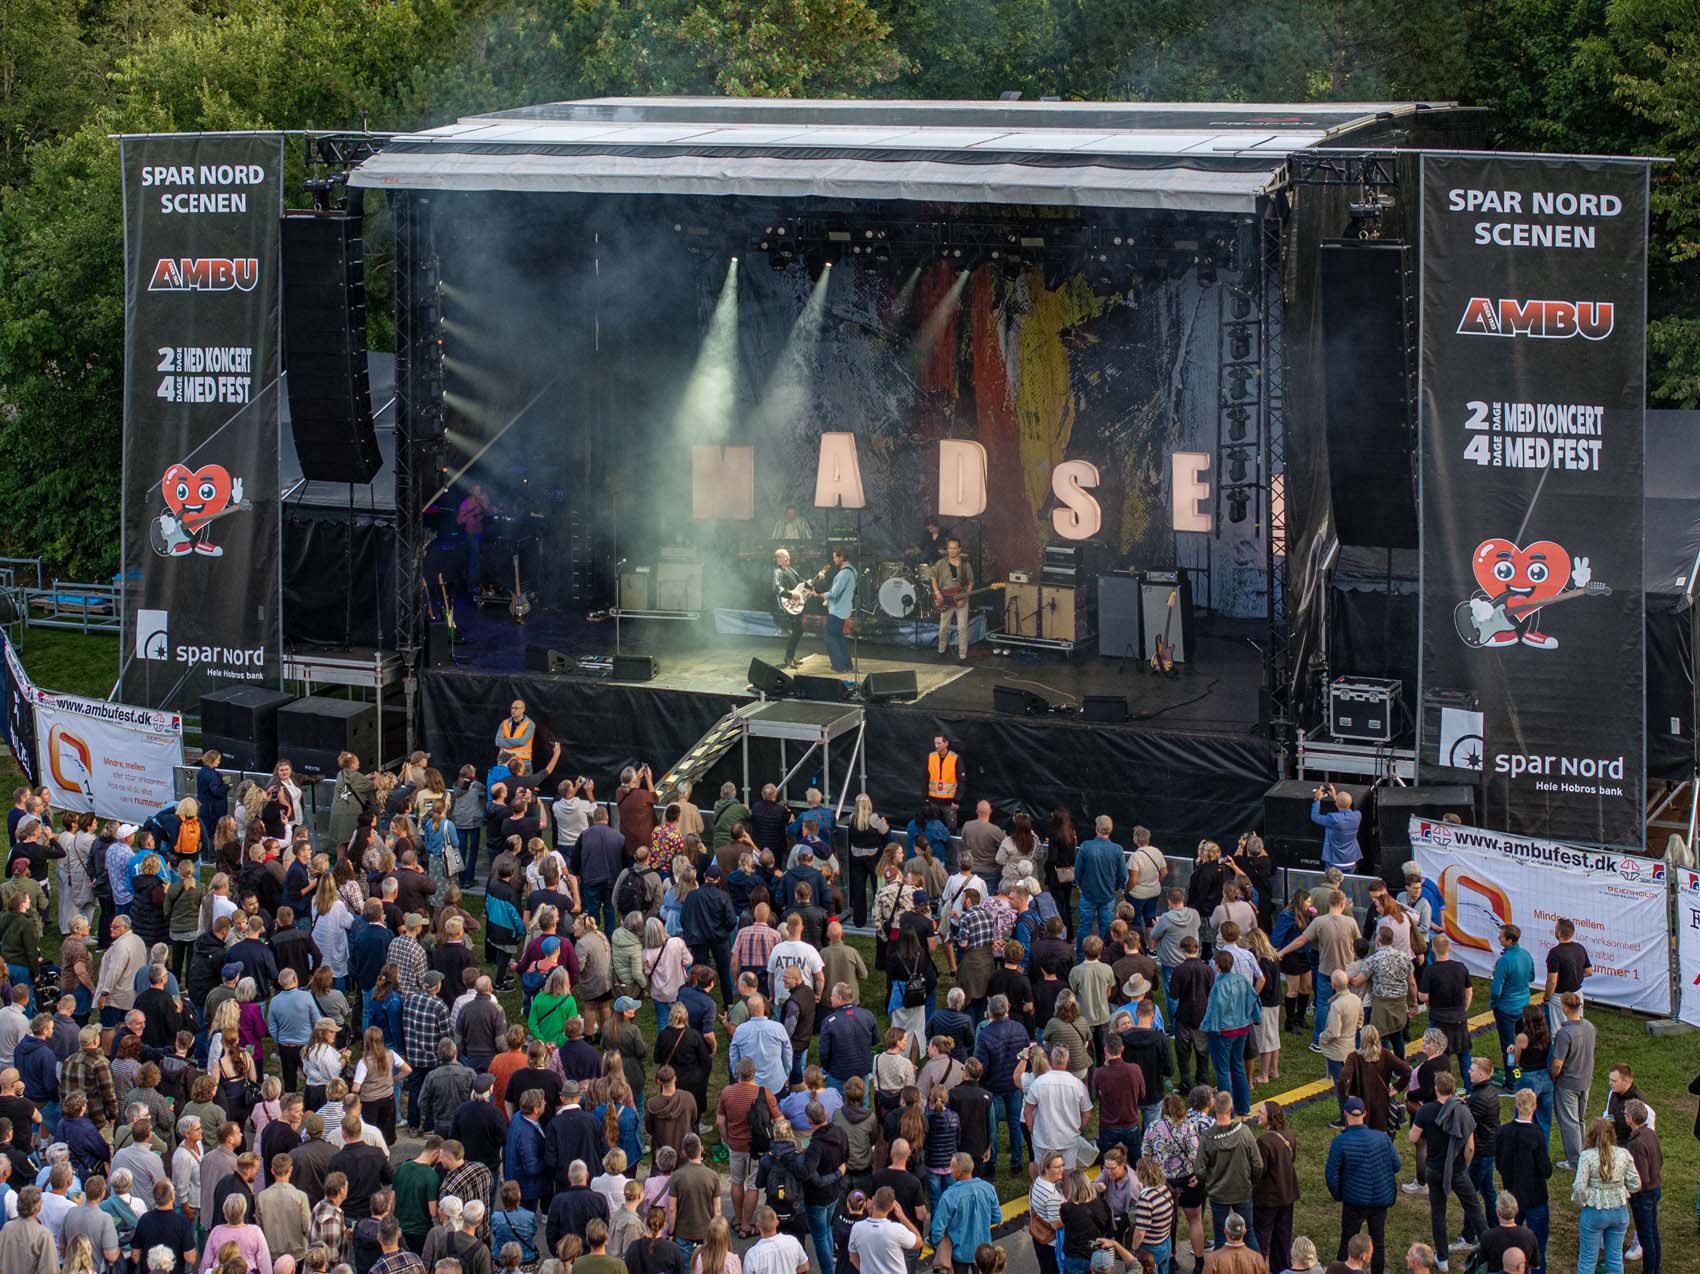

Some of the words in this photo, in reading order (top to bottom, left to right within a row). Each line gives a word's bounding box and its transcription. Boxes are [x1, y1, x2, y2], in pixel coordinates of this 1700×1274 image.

[142, 166, 195, 186] SPAR
[200, 165, 264, 185] NORD
[161, 193, 247, 214] SCENEN
[1449, 189, 1523, 213] SPAR
[1532, 192, 1622, 217] NORD
[1474, 222, 1595, 248] SCENEN
[148, 258, 259, 292] AMBU
[1456, 297, 1615, 341] AMBU
[157, 347, 175, 372] 2
[184, 347, 204, 372] MED
[206, 347, 252, 373] KONCERT
[157, 376, 175, 402] 4
[184, 376, 216, 402] MED
[218, 376, 251, 403] FEST
[1465, 401, 1489, 430] 2
[1492, 402, 1502, 431] DAGE
[1505, 403, 1535, 433] MED
[1537, 404, 1604, 435] KONCERT
[1463, 435, 1490, 465] 4
[1493, 435, 1502, 466] DAGE
[1505, 438, 1550, 469] MED
[1553, 439, 1602, 471] FEST
[246, 672, 264, 680] bank
[56, 700, 152, 726] www.ambufest.dk
[1536, 781, 1558, 791] Hele
[1561, 783, 1596, 794] Hobros
[1599, 786, 1623, 796] bank
[1454, 831, 1617, 873] www.ambufest.dk
[1573, 918, 1605, 931] mellem
[1592, 964, 1630, 977] ummer
